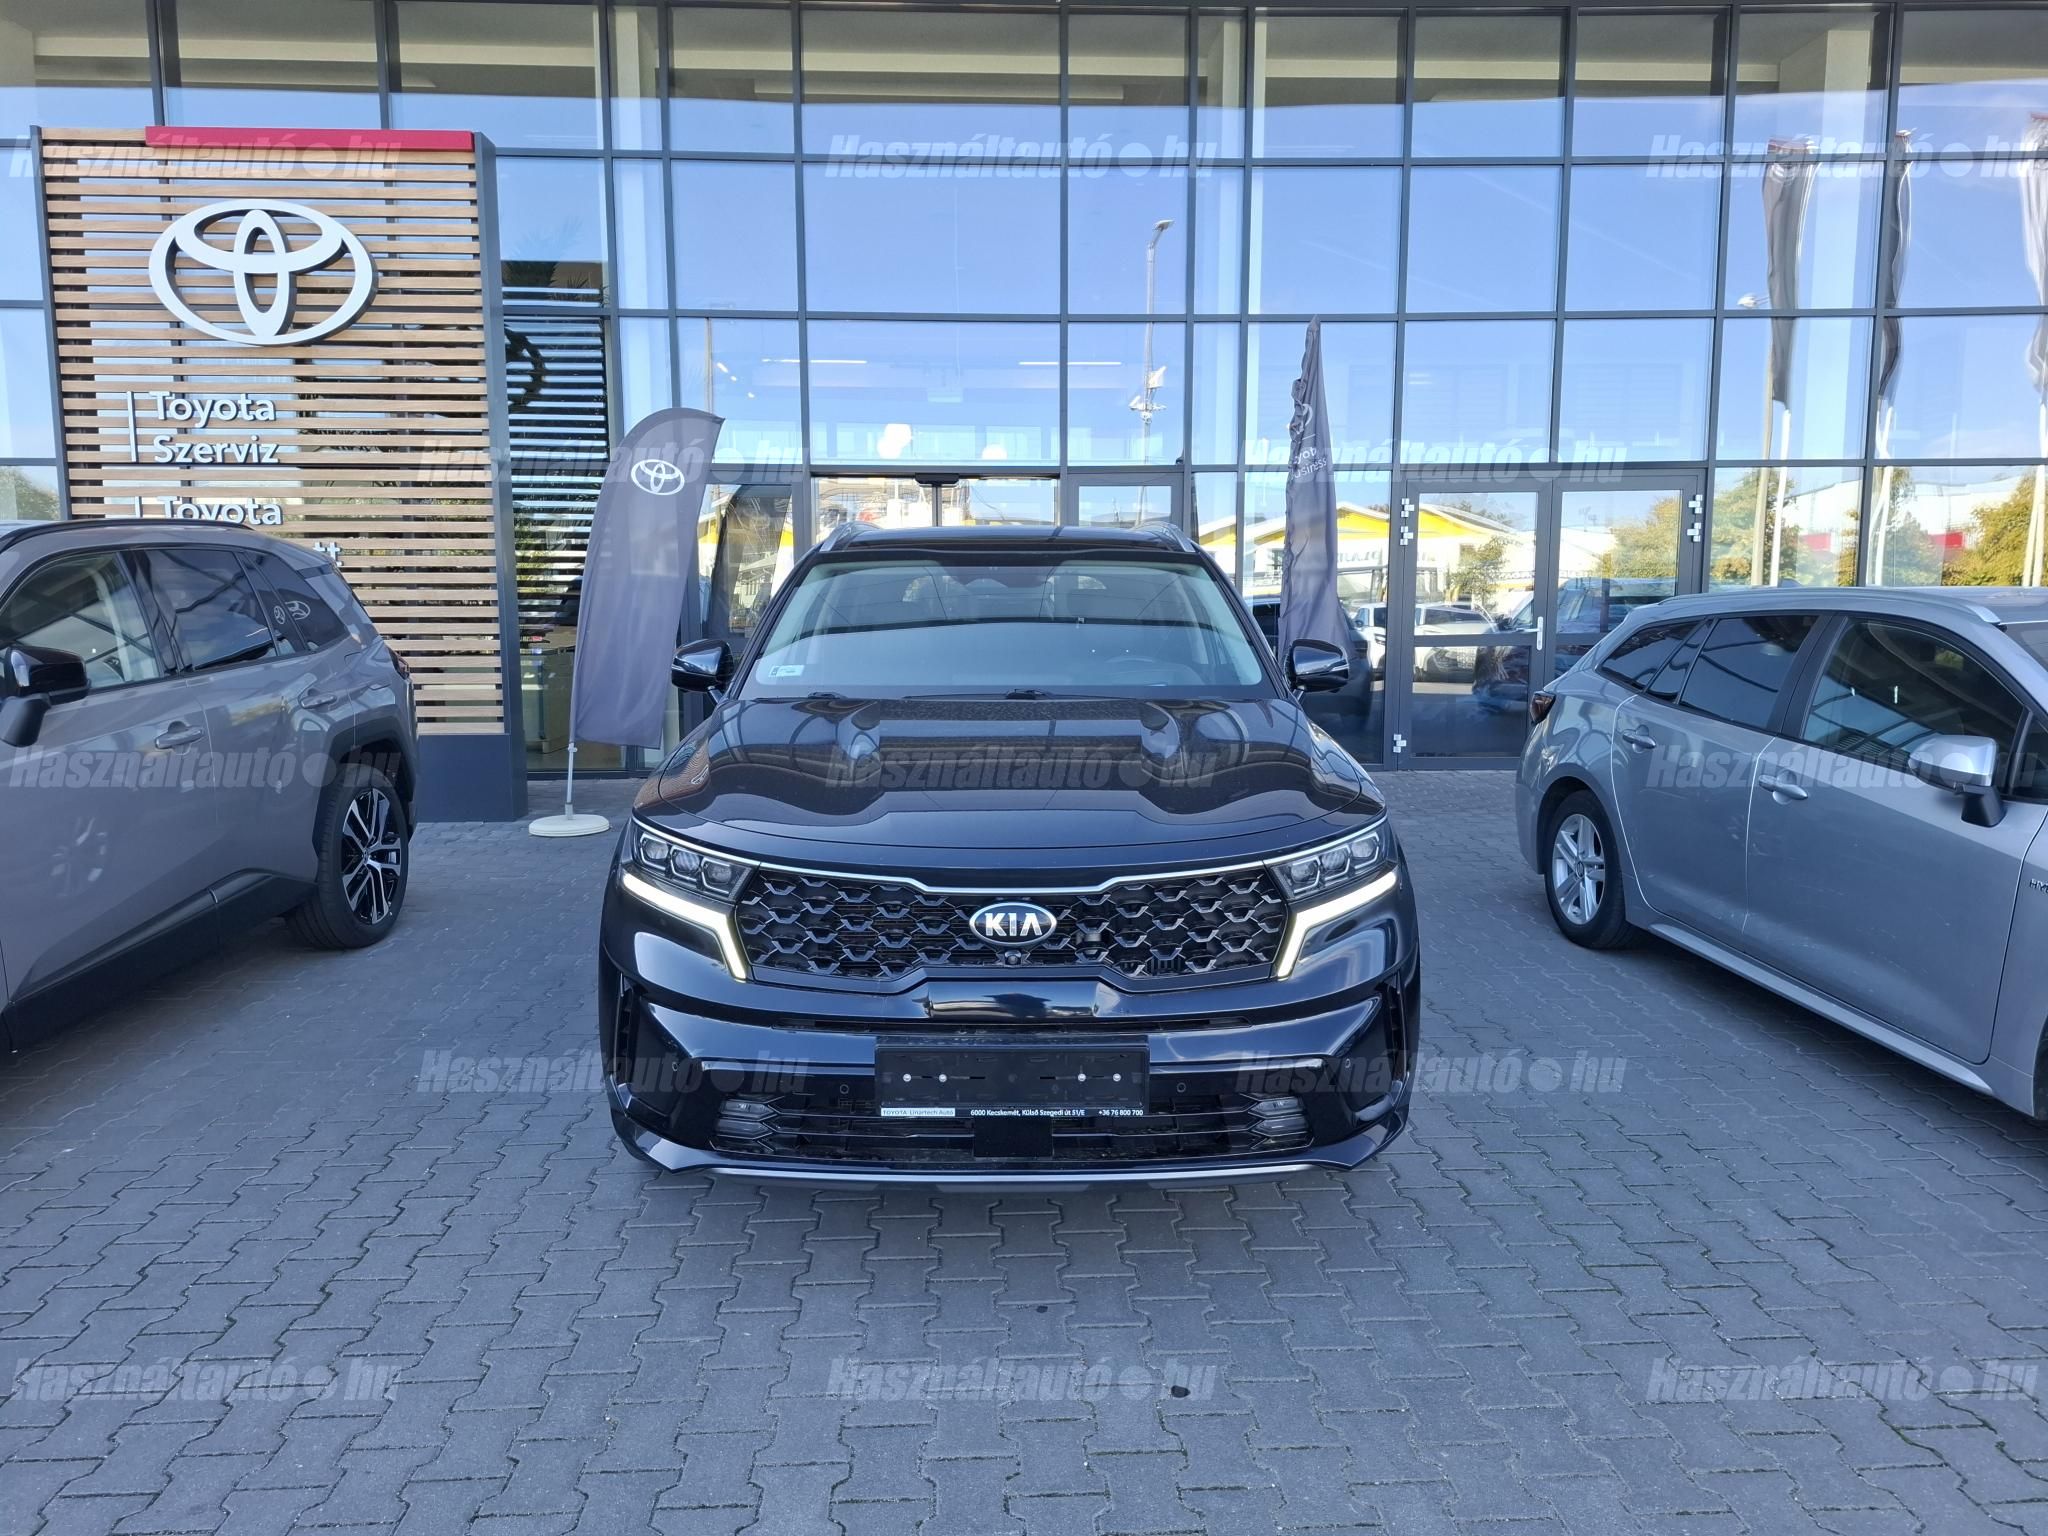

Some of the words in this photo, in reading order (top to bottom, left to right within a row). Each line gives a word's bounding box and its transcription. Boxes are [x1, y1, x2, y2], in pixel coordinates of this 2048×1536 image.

[150, 391, 276, 428] Toyota
[153, 434, 280, 463] Szerviz
[984, 912, 1043, 936] KIA
[1039, 1109, 1064, 1117] Szegedi
